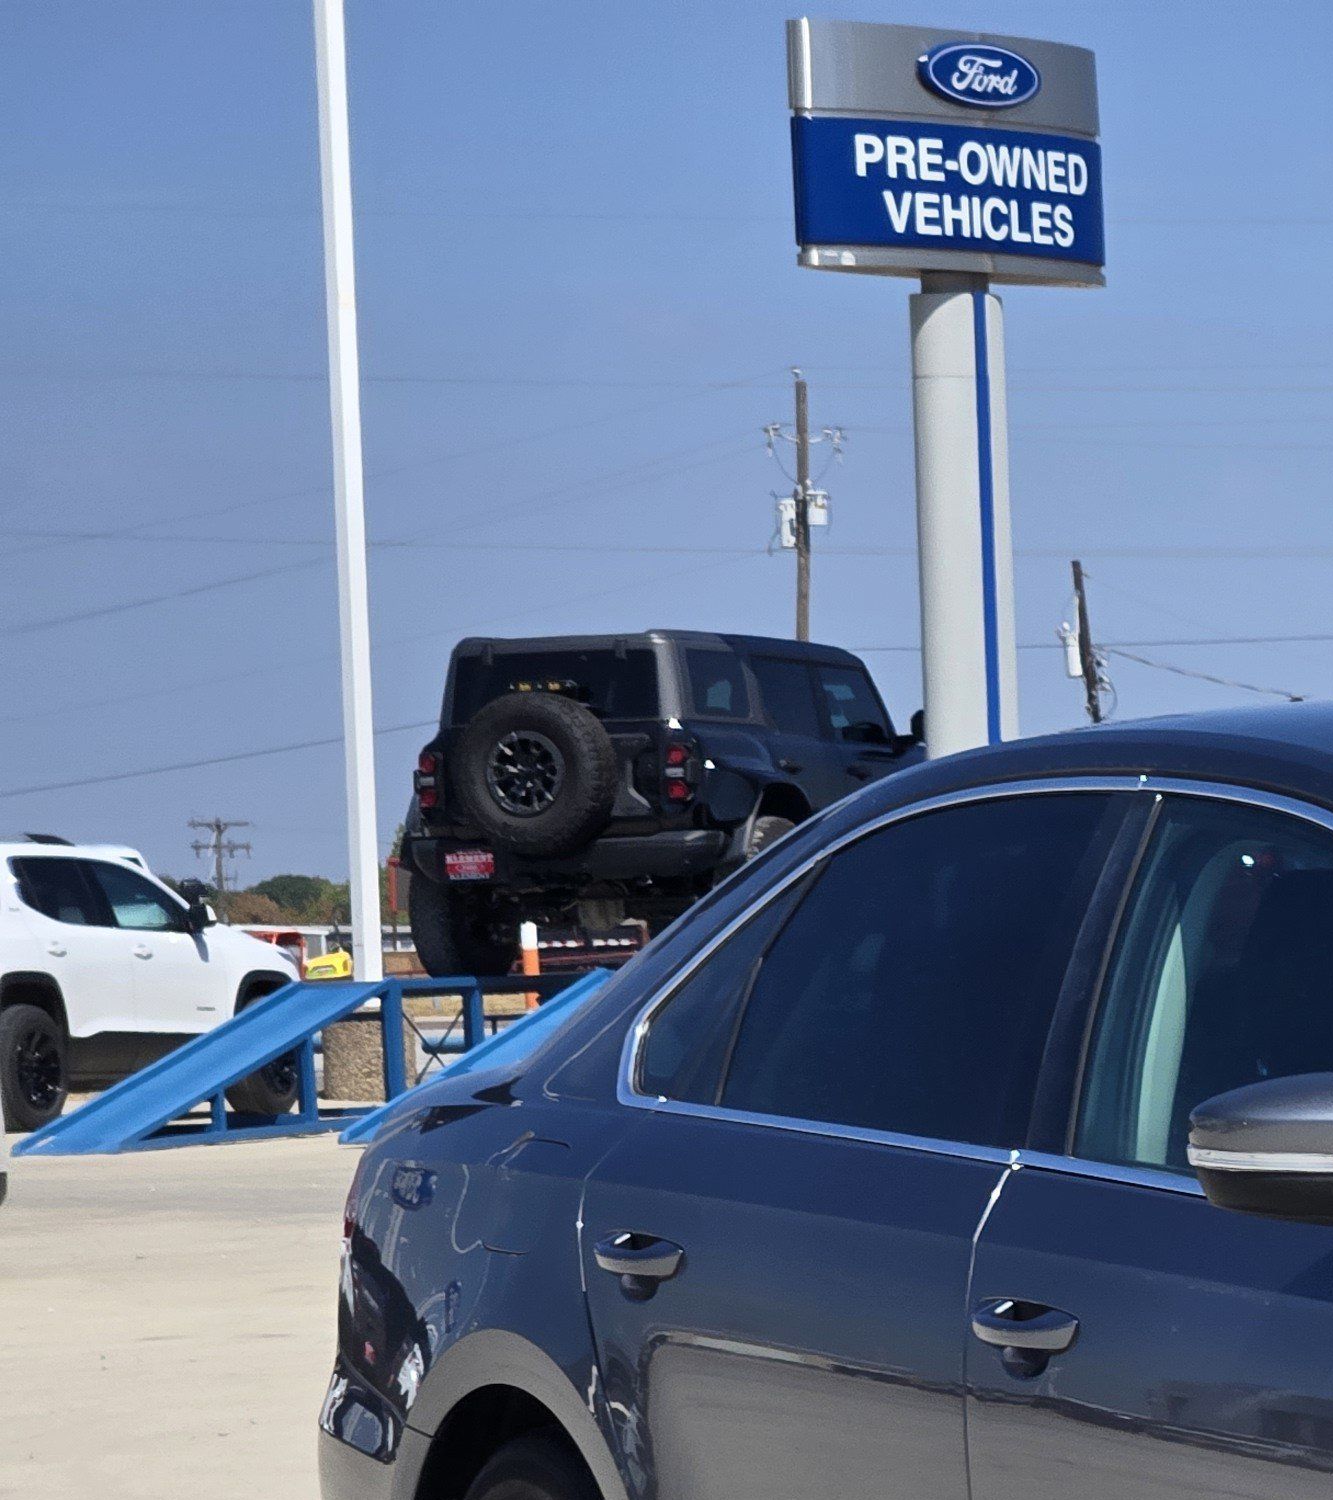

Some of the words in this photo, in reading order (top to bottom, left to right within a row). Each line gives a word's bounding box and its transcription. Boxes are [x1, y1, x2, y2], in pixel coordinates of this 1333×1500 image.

[952, 54, 1018, 97] Ford
[854, 133, 1088, 196] PRE-OWNED
[882, 190, 1075, 248] VEHICLES
